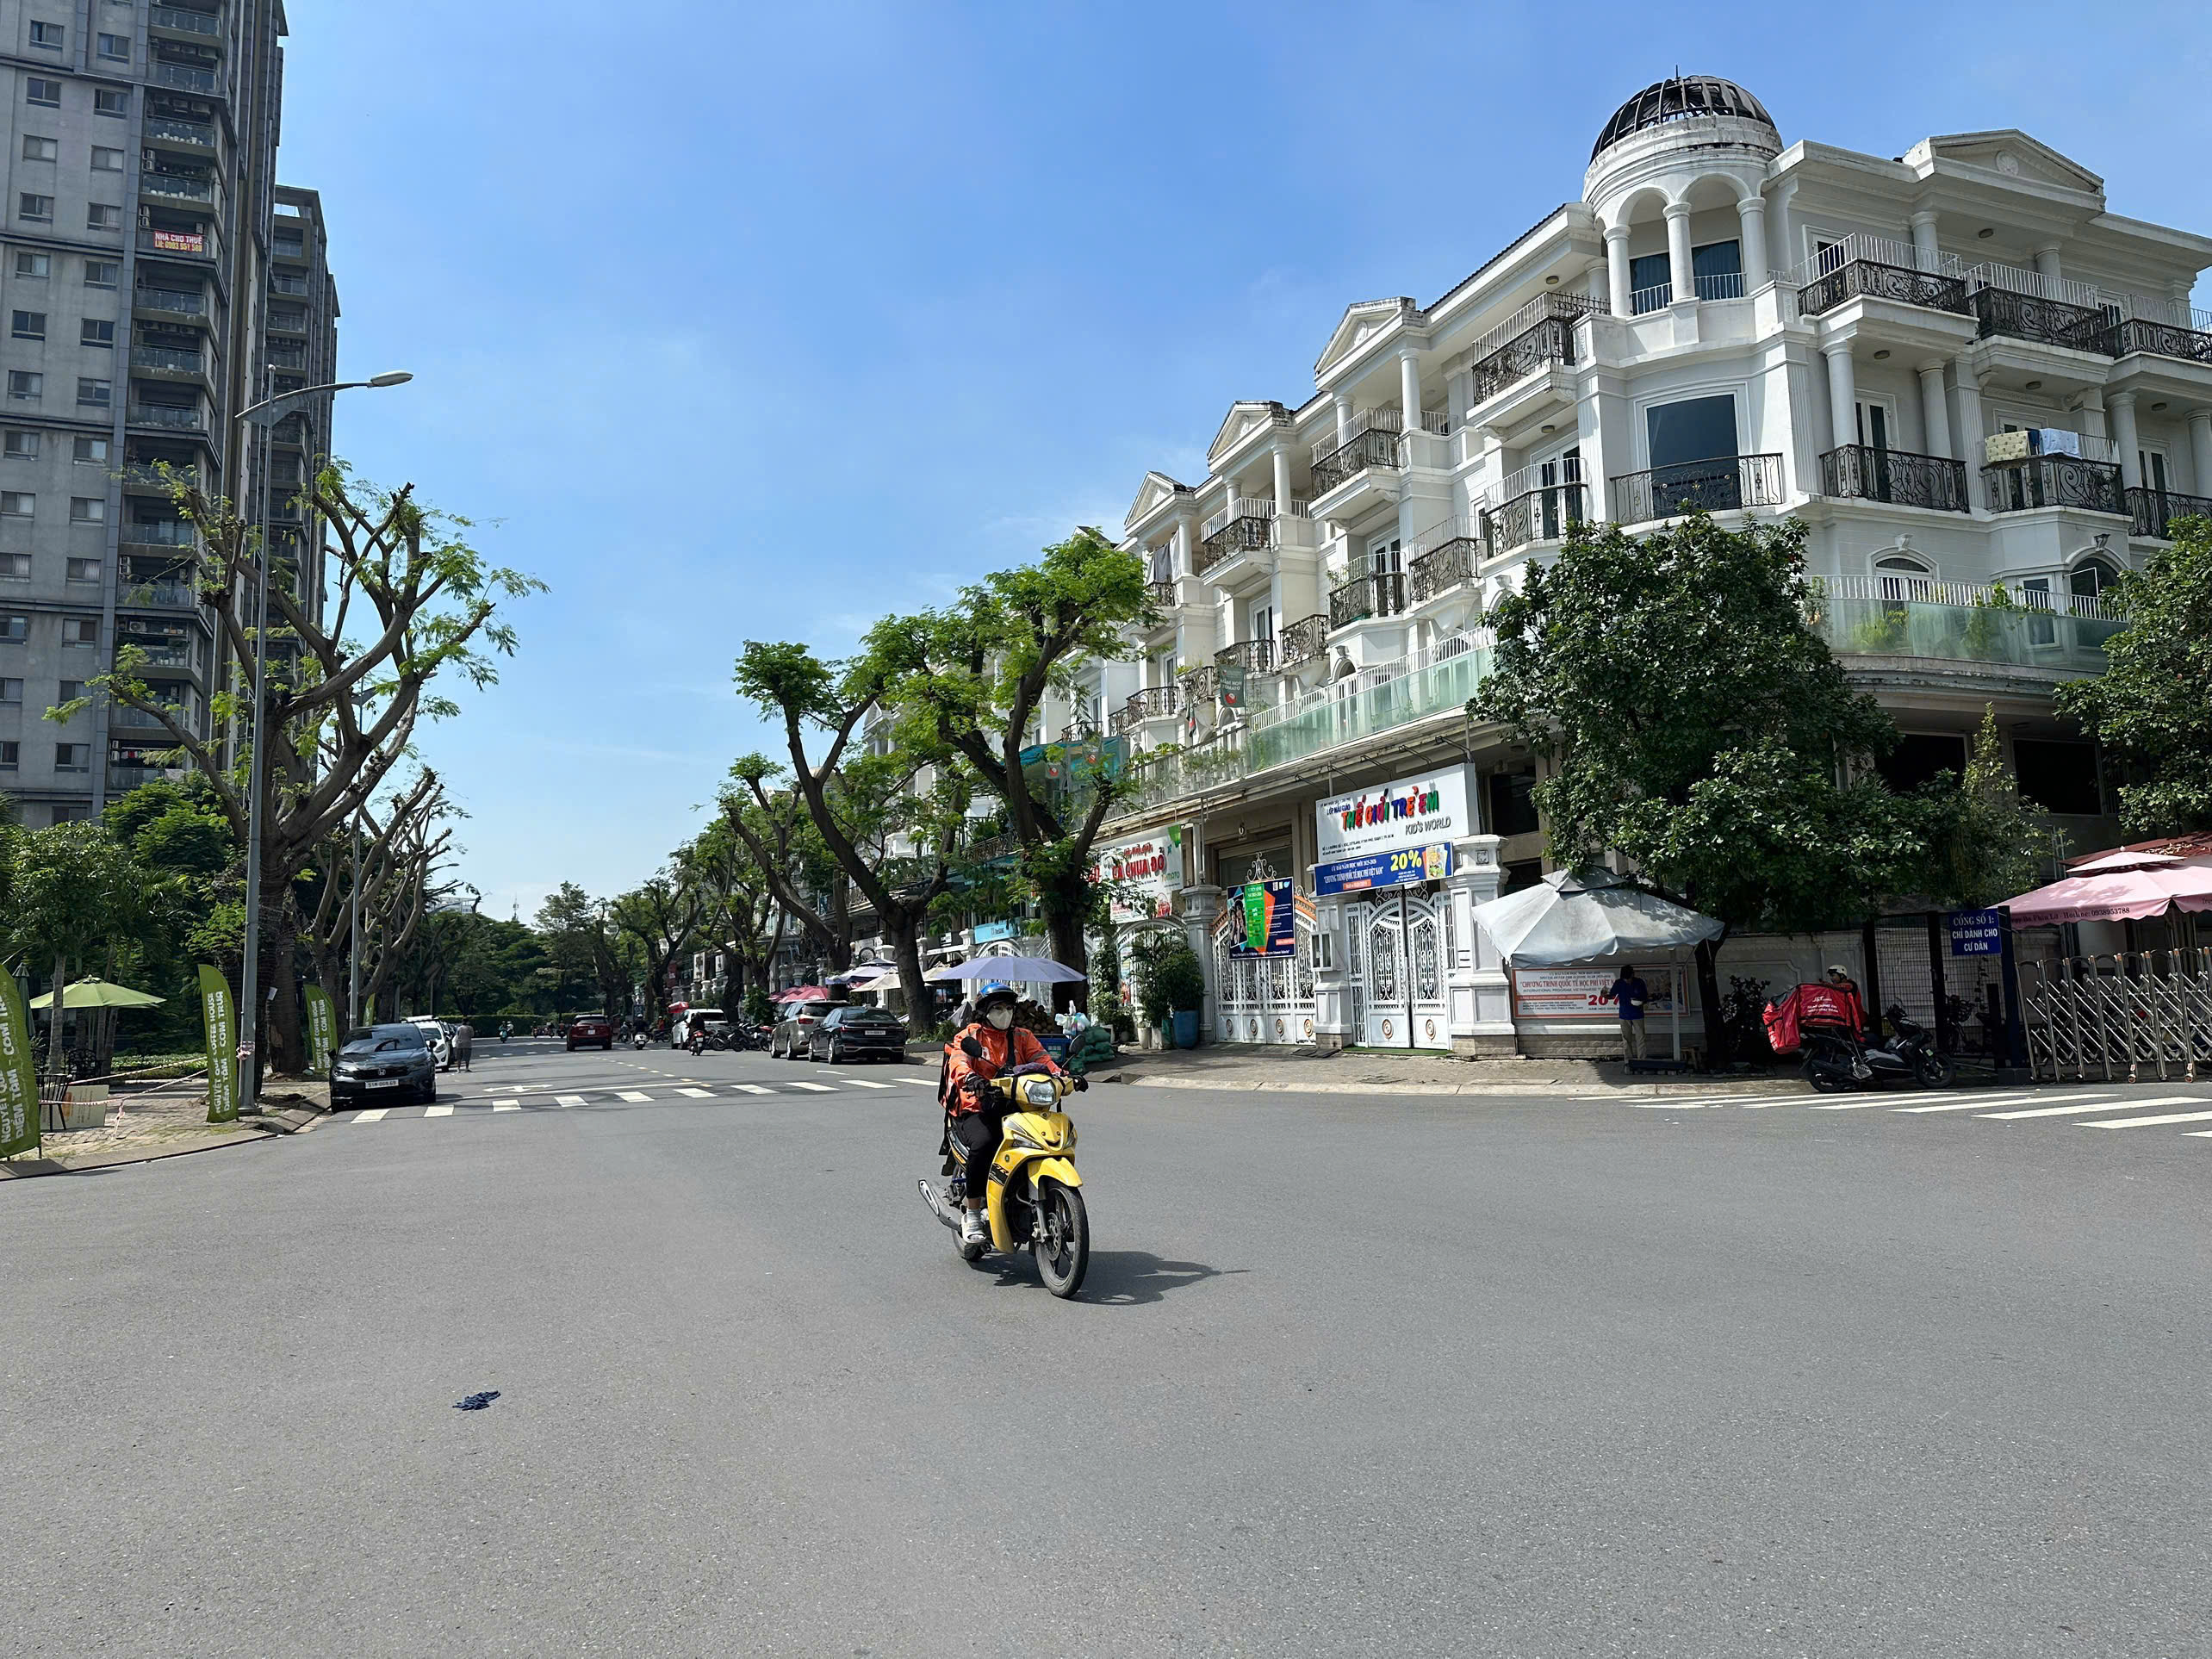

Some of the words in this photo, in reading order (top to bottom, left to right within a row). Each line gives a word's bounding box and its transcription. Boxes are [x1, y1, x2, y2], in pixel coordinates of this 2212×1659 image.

[1419, 790, 1439, 815] EM
[1424, 817, 1451, 832] WORLD
[1390, 849, 1422, 872] 20%
[1984, 928, 1998, 937] CHO
[1974, 940, 1988, 951] DÂN
[207, 992, 215, 1022] HOUSE
